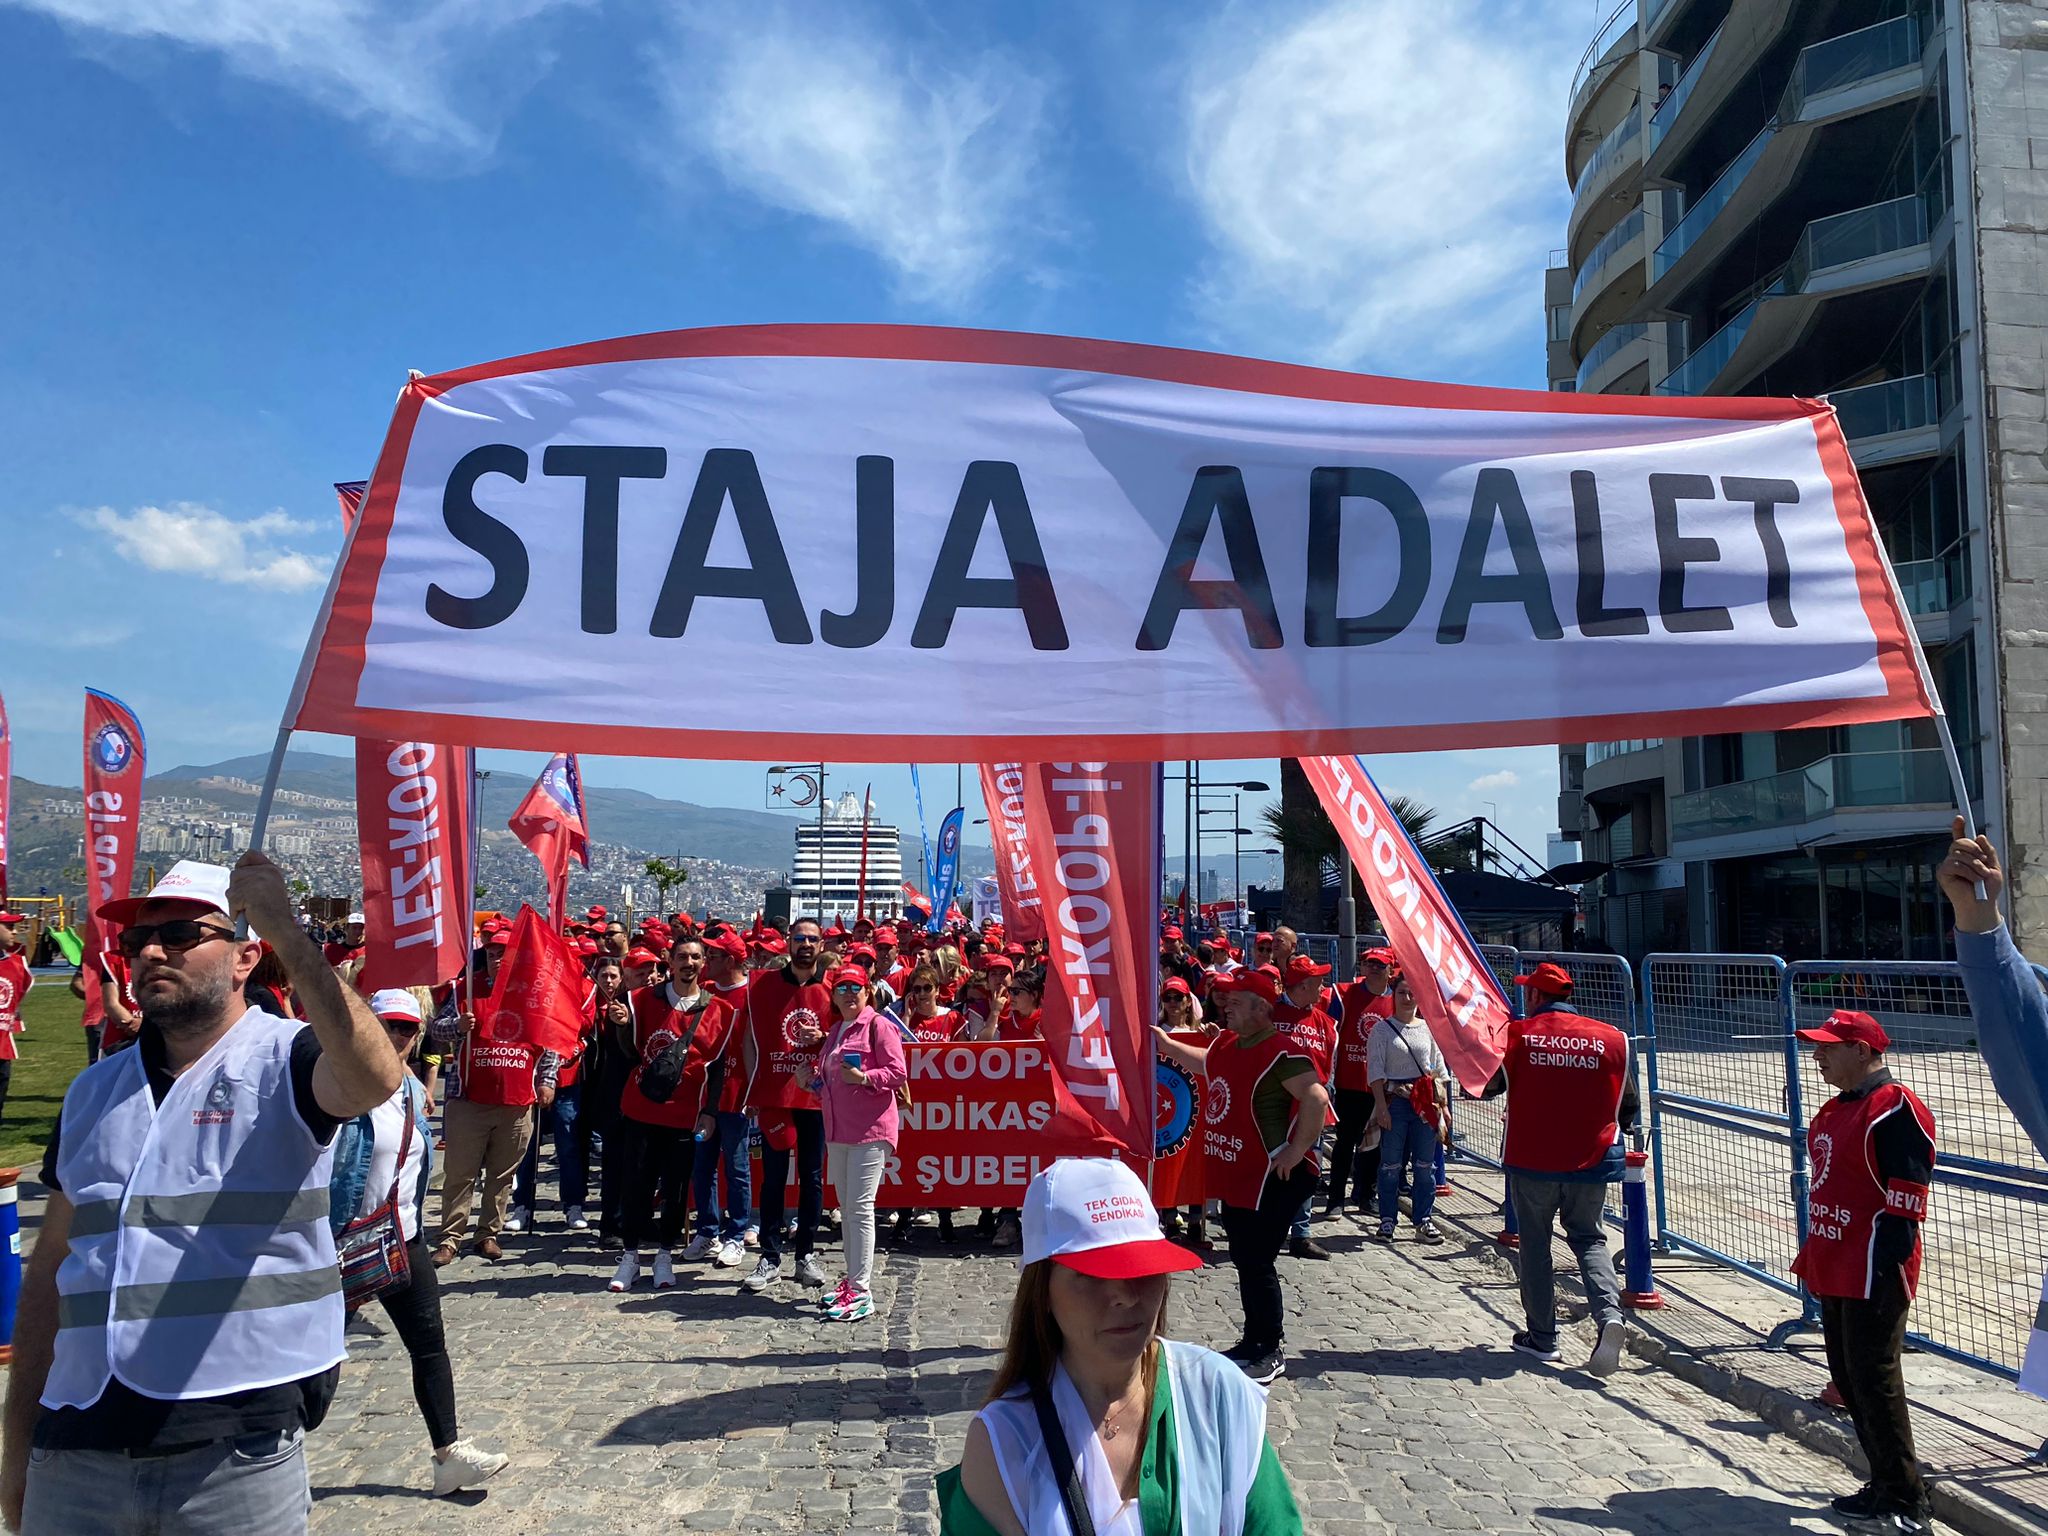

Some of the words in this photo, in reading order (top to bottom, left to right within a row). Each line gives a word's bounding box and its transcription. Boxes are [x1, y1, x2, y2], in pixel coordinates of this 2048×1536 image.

[425, 444, 1069, 649] STAJA
[1135, 465, 1800, 651] ADALET
[978, 900, 1001, 917] TE
[1290, 1035, 1326, 1051] NDİKASI
[1522, 1034, 1605, 1055] TEZ-KOOP-İŞ
[475, 1057, 526, 1069] SENDİKASI
[1529, 1051, 1599, 1069] SENDİKASI
[899, 1095, 1060, 1131] NDİKAS
[1204, 1130, 1243, 1151] OOP-İŞ
[1204, 1143, 1237, 1162] DİKASI
[1084, 1199, 1109, 1212] TEK
[1886, 1189, 1923, 1214] REVL
[1810, 1201, 1851, 1226] OOP-İŞ
